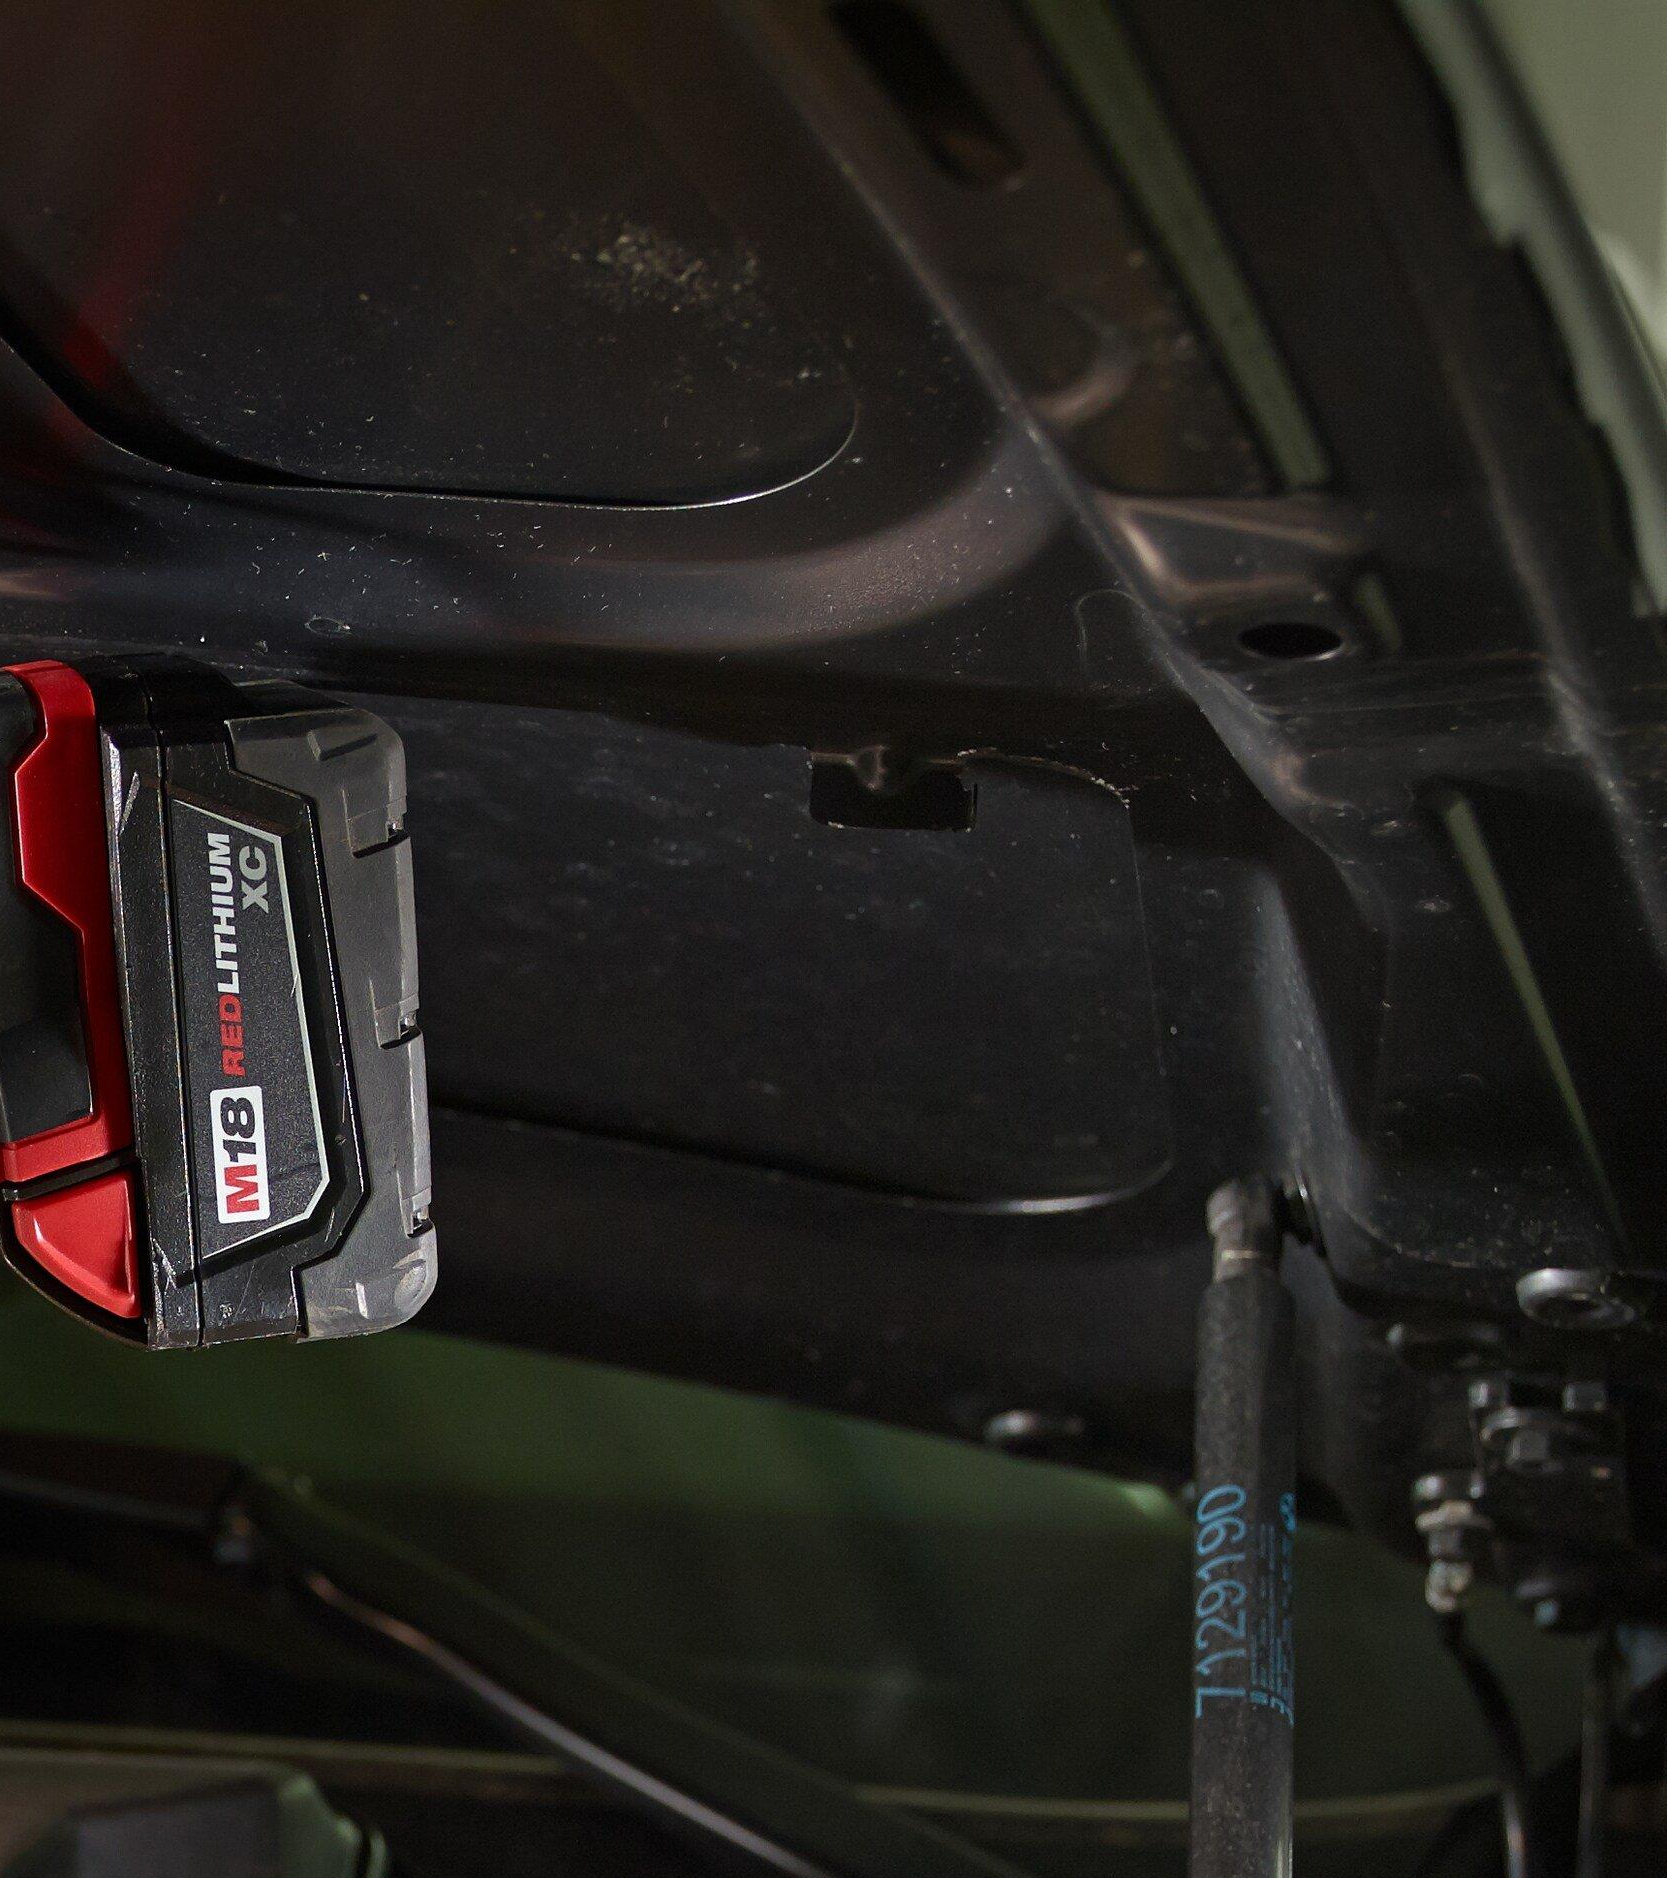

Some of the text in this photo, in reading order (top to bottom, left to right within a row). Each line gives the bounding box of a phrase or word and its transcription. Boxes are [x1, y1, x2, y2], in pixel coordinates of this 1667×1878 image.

[238, 845, 268, 913] XC
[207, 833, 260, 1214] M18 REDLITHIUM
[1196, 1484, 1247, 1719] 7129190
